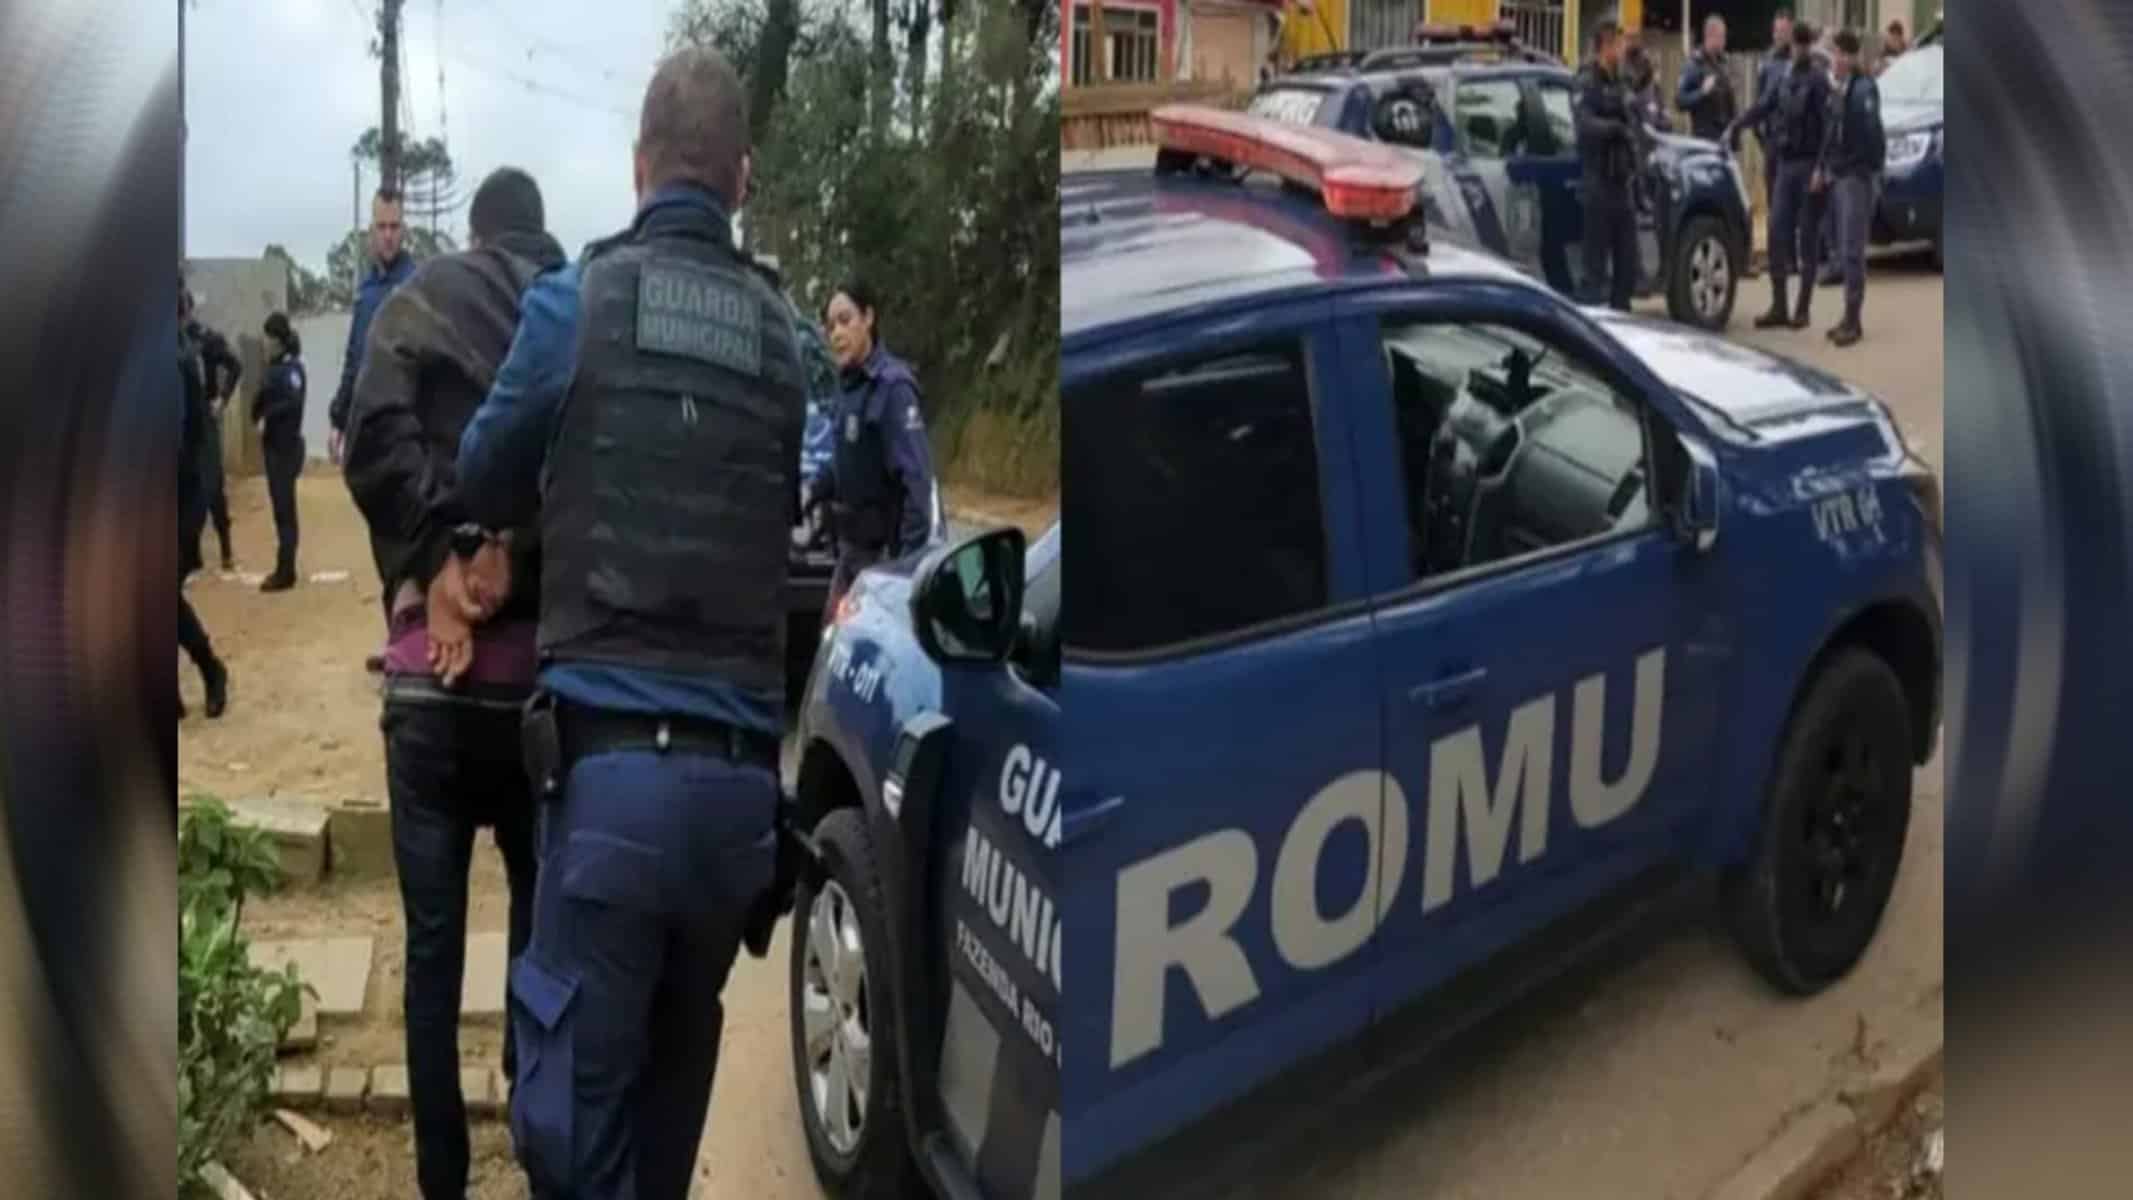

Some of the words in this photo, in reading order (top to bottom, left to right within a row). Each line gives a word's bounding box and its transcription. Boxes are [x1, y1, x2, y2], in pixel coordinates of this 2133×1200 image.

[645, 274, 756, 332] GUARDA
[1109, 645, 1667, 1071] ROMU
[1021, 995, 1054, 1057] RIO
